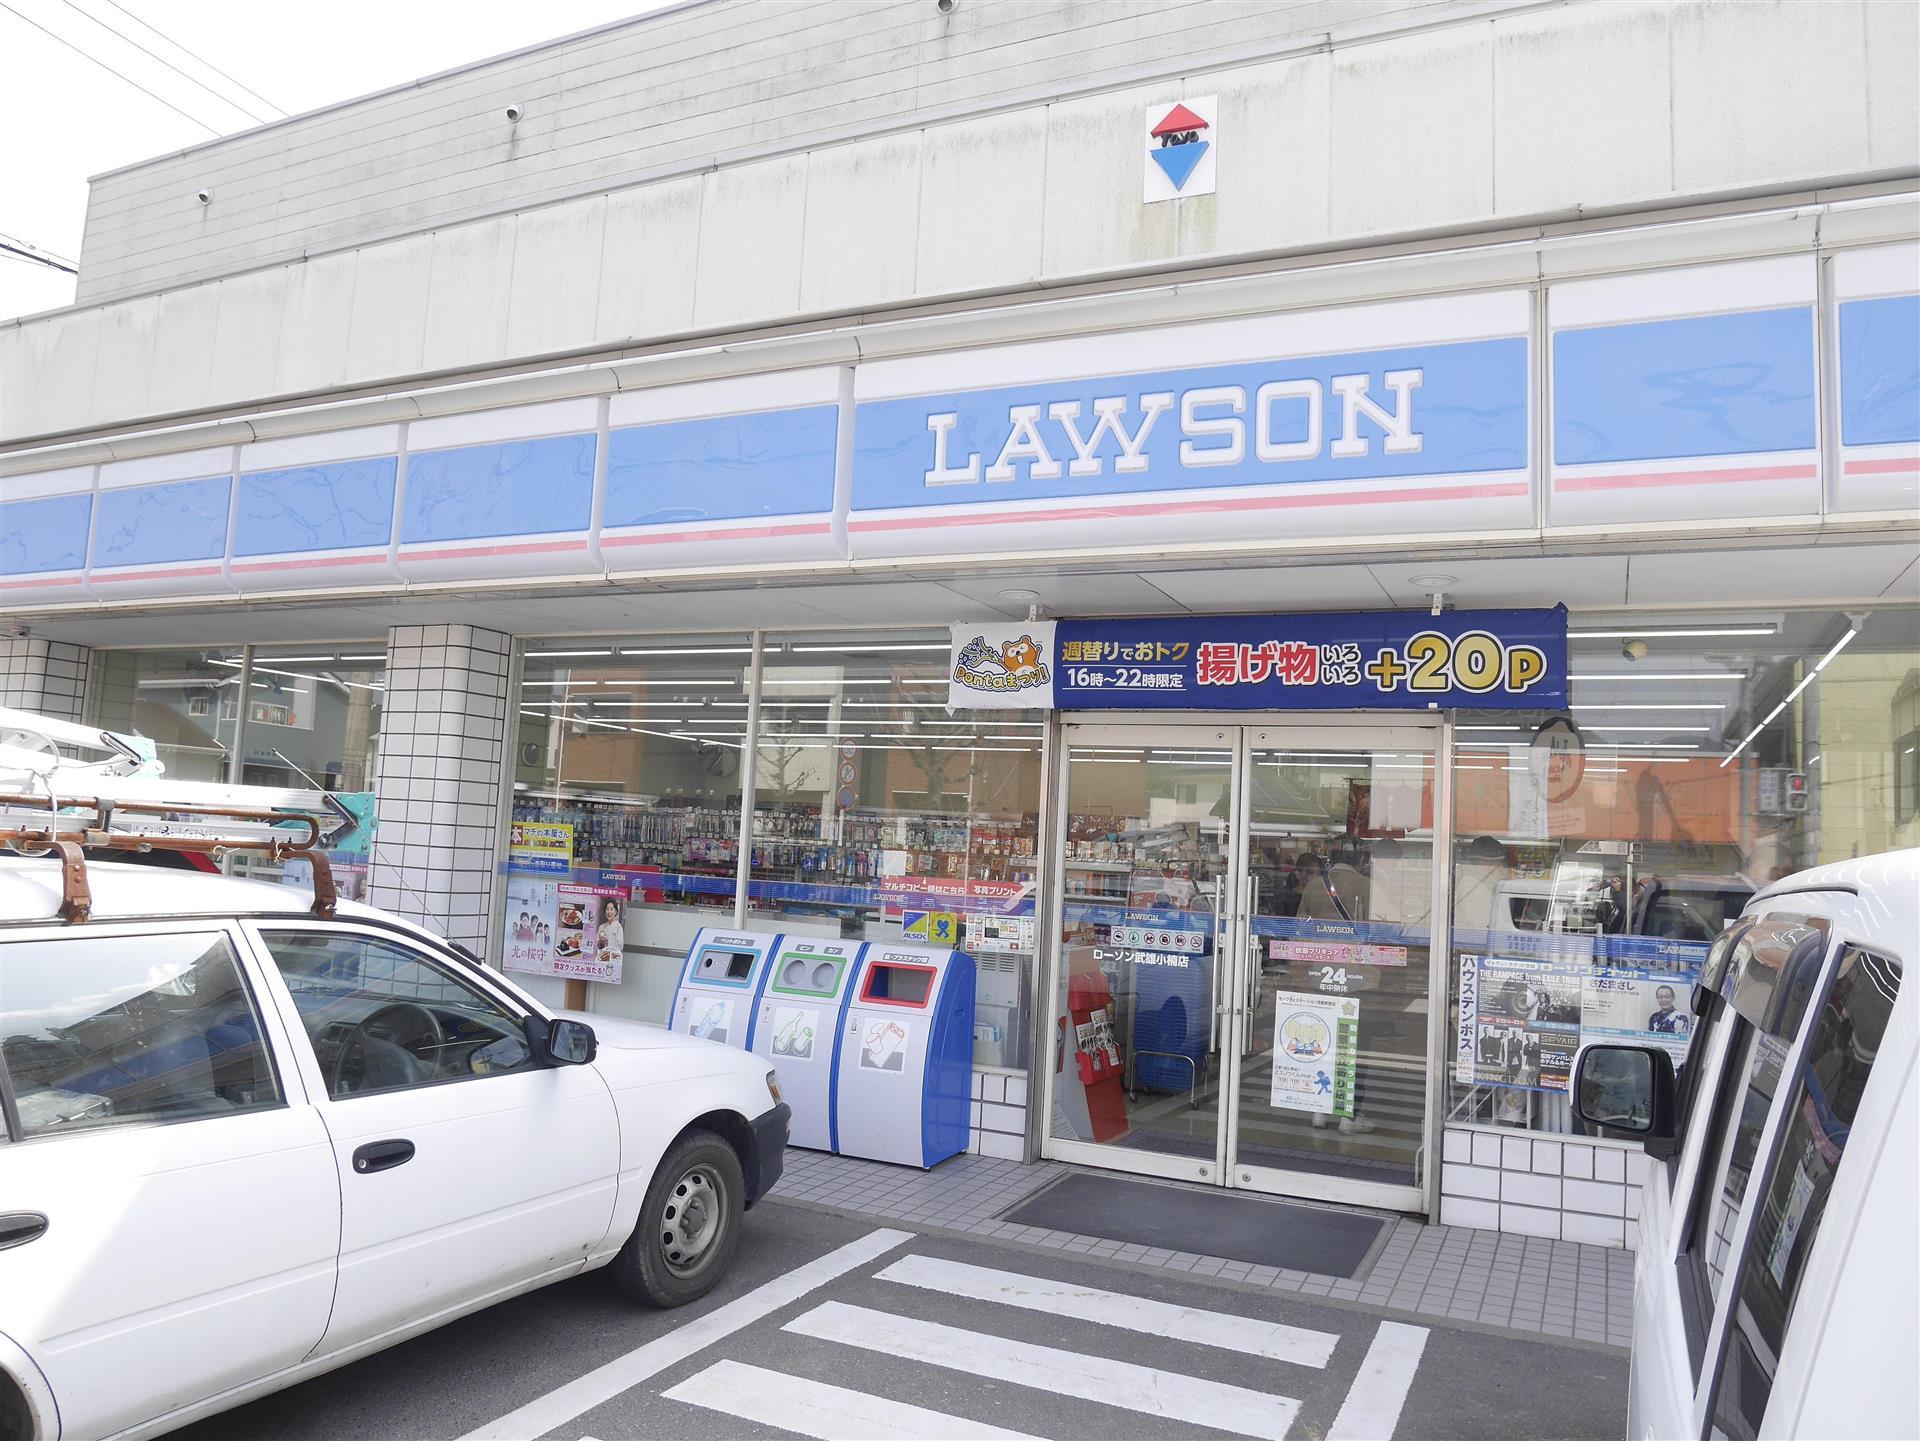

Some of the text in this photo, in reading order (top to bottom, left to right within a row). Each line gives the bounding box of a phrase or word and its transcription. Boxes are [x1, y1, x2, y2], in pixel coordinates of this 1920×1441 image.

[924, 367, 1424, 487] LAWSON
[1062, 641, 1190, 661] 週替りでおトク
[1198, 642, 1319, 684] 揚げ物
[523, 827, 570, 839] マチの本屋さん
[884, 881, 965, 896] マルチコピー機はこちら
[973, 884, 1018, 897] 写真プリント
[1125, 912, 1159, 921] LAWSON
[903, 933, 926, 941] ALSOK
[1316, 924, 1355, 935] LAWSON
[511, 944, 547, 961] 北の桜守
[1093, 949, 1190, 968] ローソン武雄小楠店
[1321, 966, 1347, 985] 24
[1480, 969, 1493, 978] THE
[1493, 970, 1525, 980] RAMPAGE
[1525, 973, 1541, 981] from
[1542, 974, 1561, 983] EXILE
[1561, 976, 1581, 985] TRIBE
[1319, 983, 1349, 992] 年中無休
[1590, 979, 1635, 991] さだまさし
[1460, 957, 1476, 1050] ハウステンボス
[1541, 1035, 1577, 1046] SPYAIR
